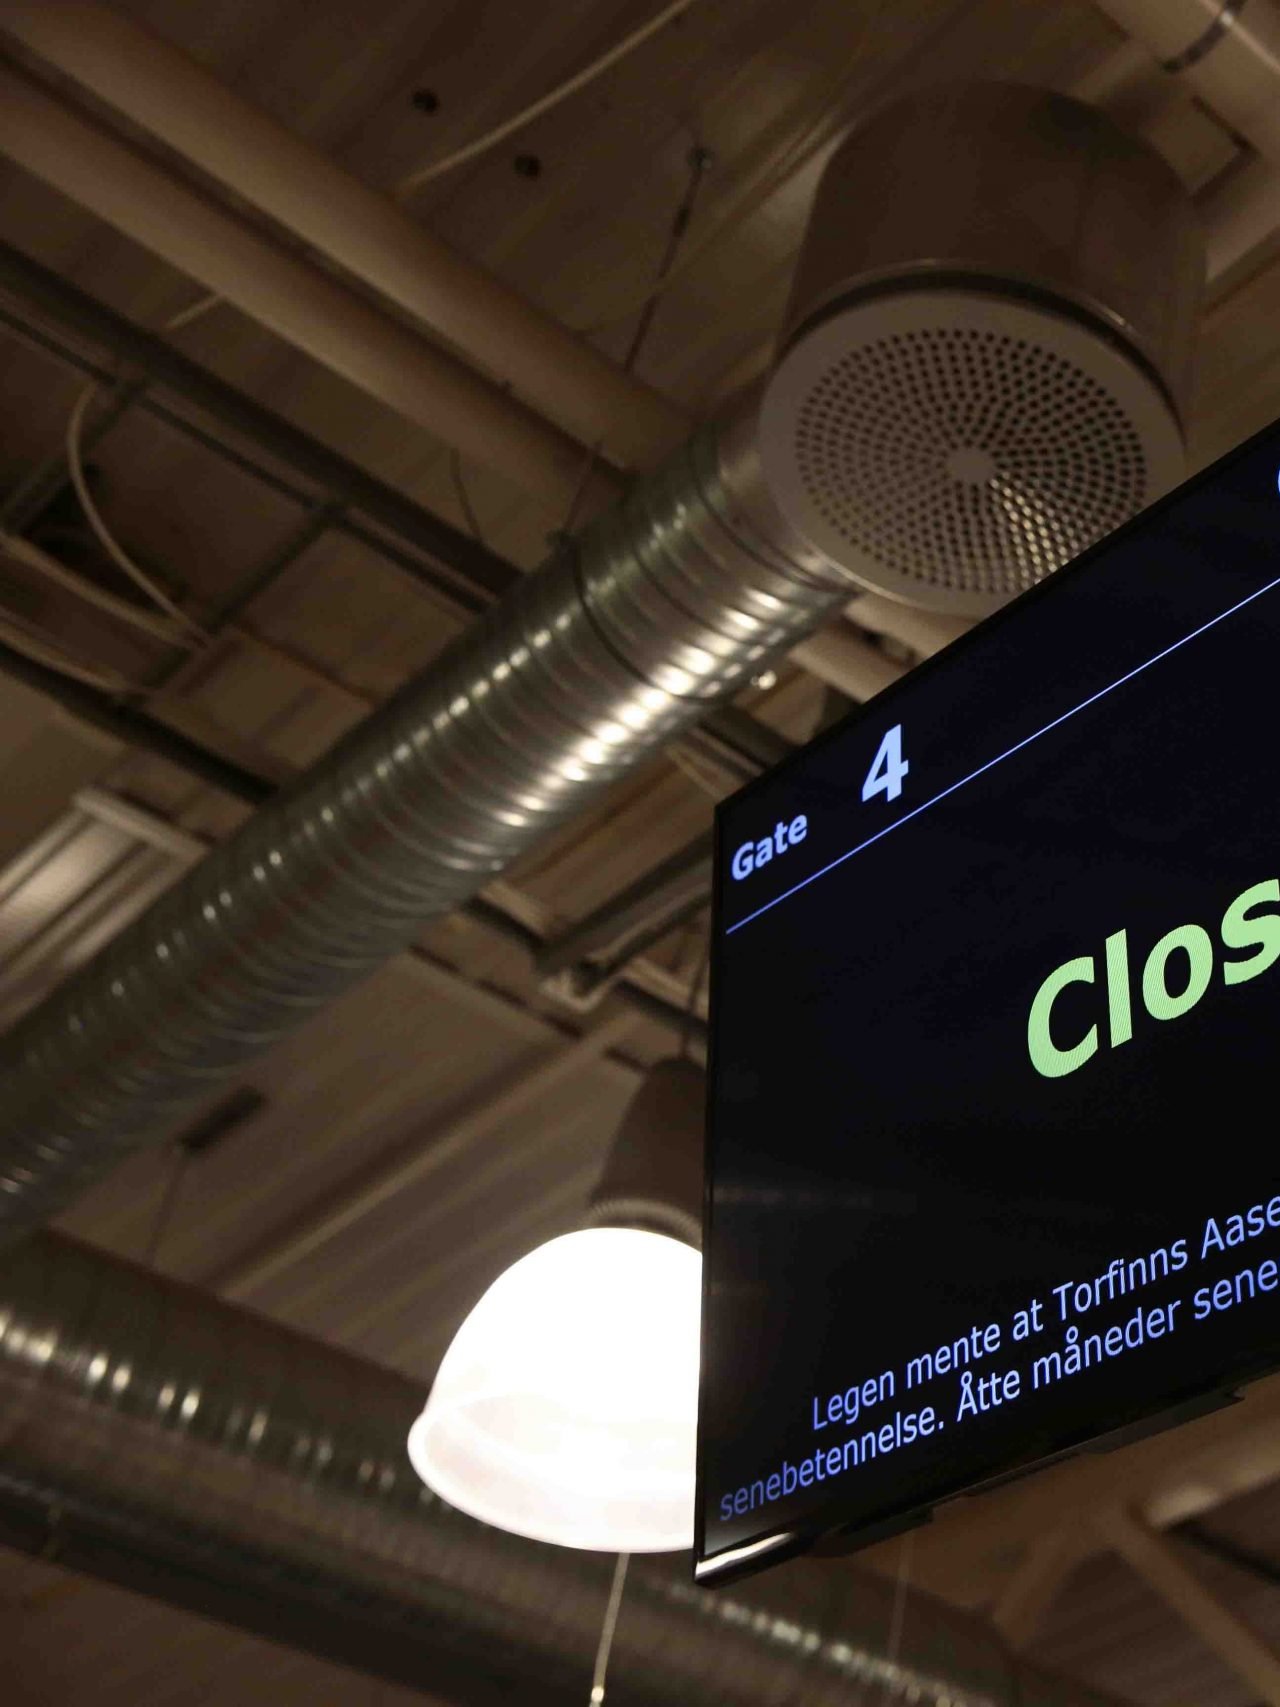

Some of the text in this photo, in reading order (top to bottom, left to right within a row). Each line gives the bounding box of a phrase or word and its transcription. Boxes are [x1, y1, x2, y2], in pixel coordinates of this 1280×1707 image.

[731, 723, 909, 881] Gate 4
[718, 1406, 945, 1522] senebetennelse.
[956, 1369, 1021, 1421] Åtte
[1032, 1298, 1182, 1390] måneder
[811, 1369, 895, 1431] Legen
[905, 1320, 1001, 1390] mente
[1011, 1297, 1044, 1342] at
[1052, 1234, 1189, 1322] Torfinns
